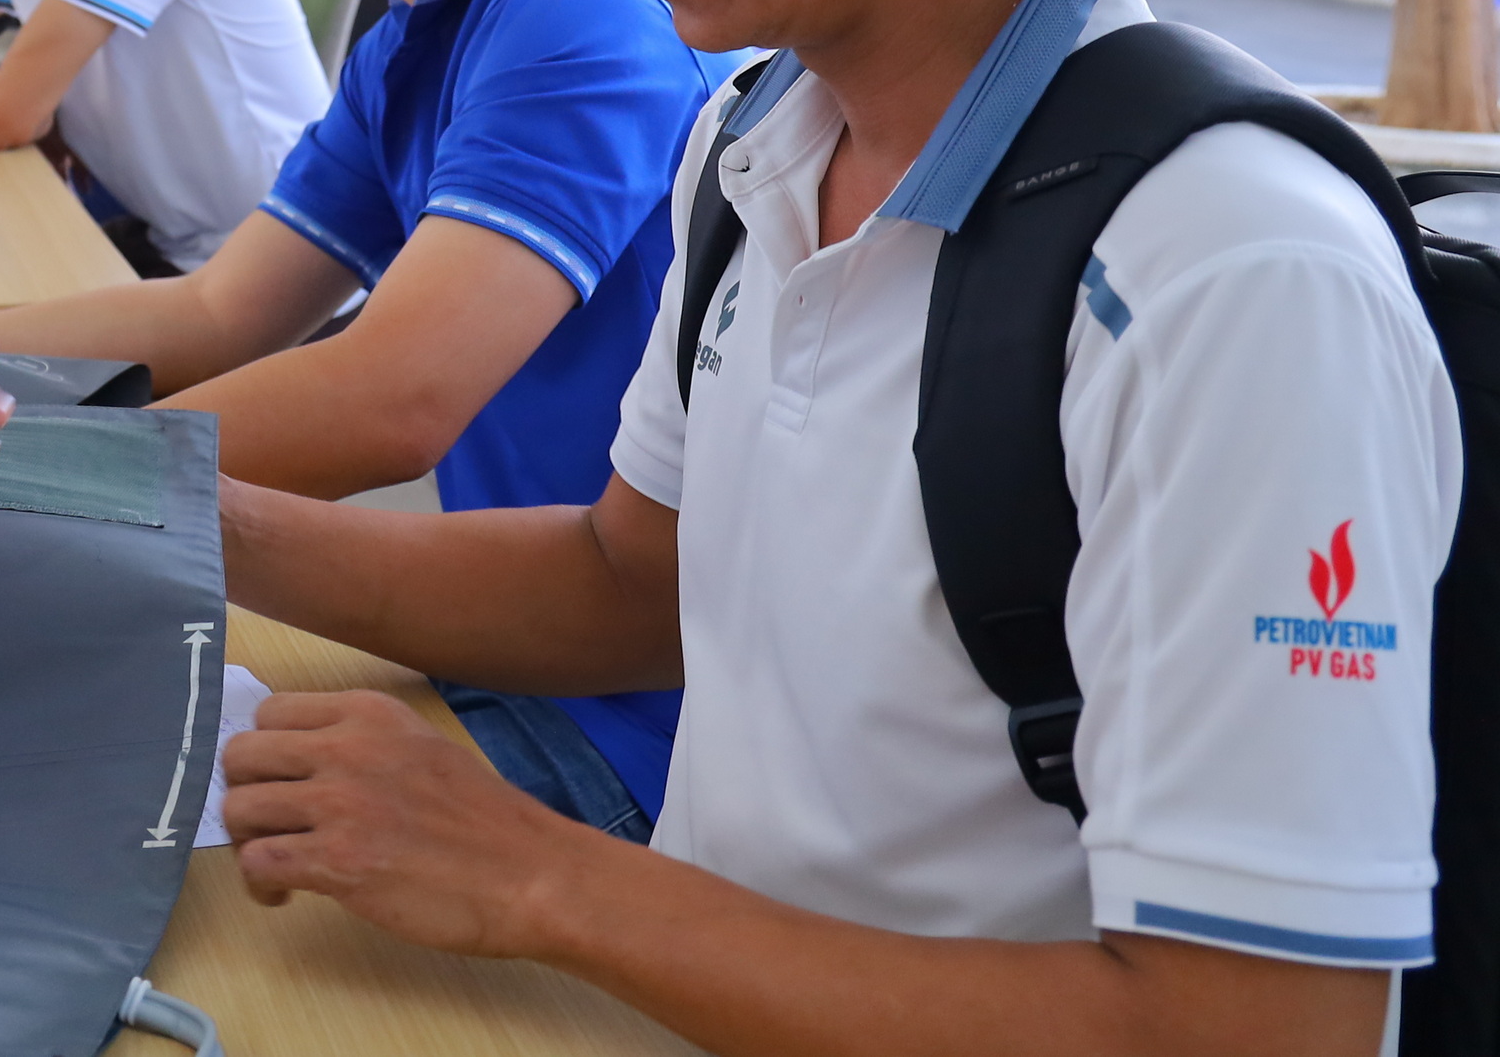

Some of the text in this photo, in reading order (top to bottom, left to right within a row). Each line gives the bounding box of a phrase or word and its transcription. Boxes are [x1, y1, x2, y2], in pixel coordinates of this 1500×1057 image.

[1255, 616, 1397, 651] PETROVIETNAM
[1290, 648, 1376, 681] PV GAS
